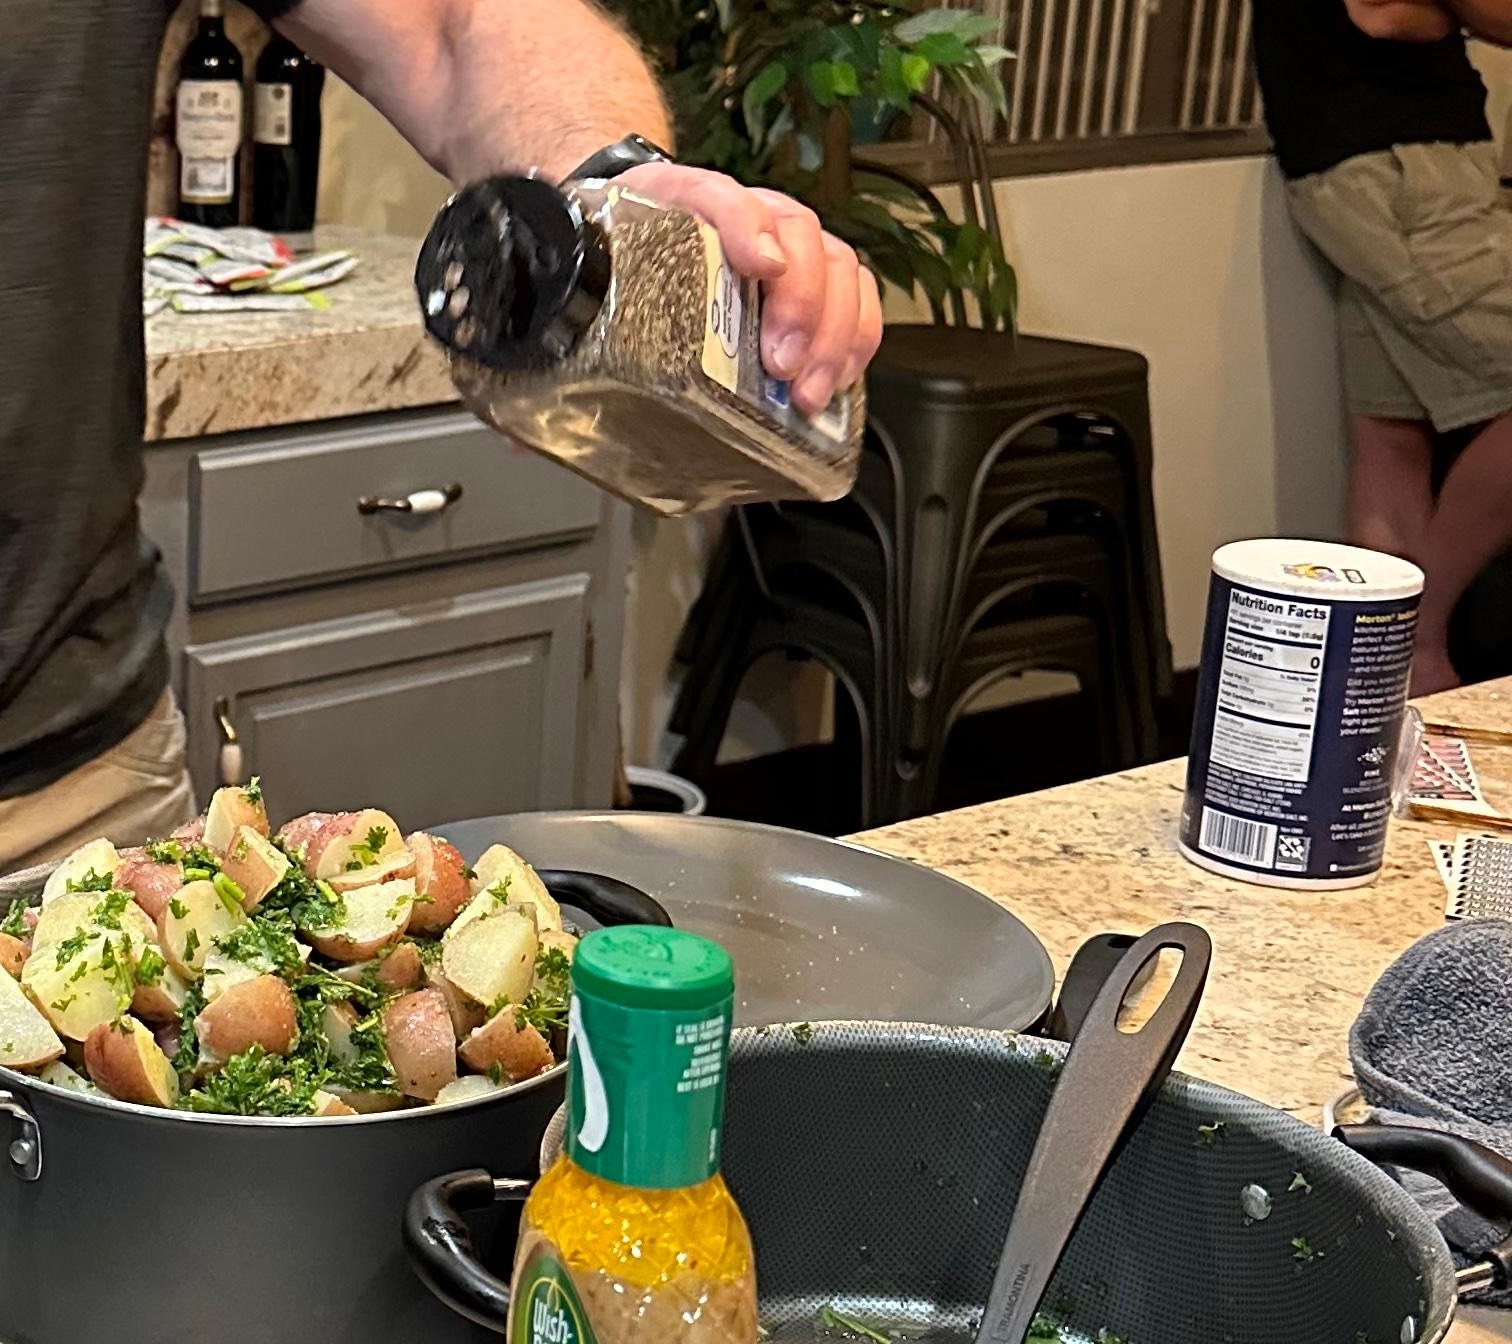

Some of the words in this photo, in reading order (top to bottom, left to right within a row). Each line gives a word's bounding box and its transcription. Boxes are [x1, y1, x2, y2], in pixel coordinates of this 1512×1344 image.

[1231, 591, 1284, 615] Nutrition
[1288, 604, 1327, 620] Facts
[1225, 642, 1264, 661] Calories
[1310, 656, 1321, 669] 0
[532, 1297, 574, 1344] Wish-
